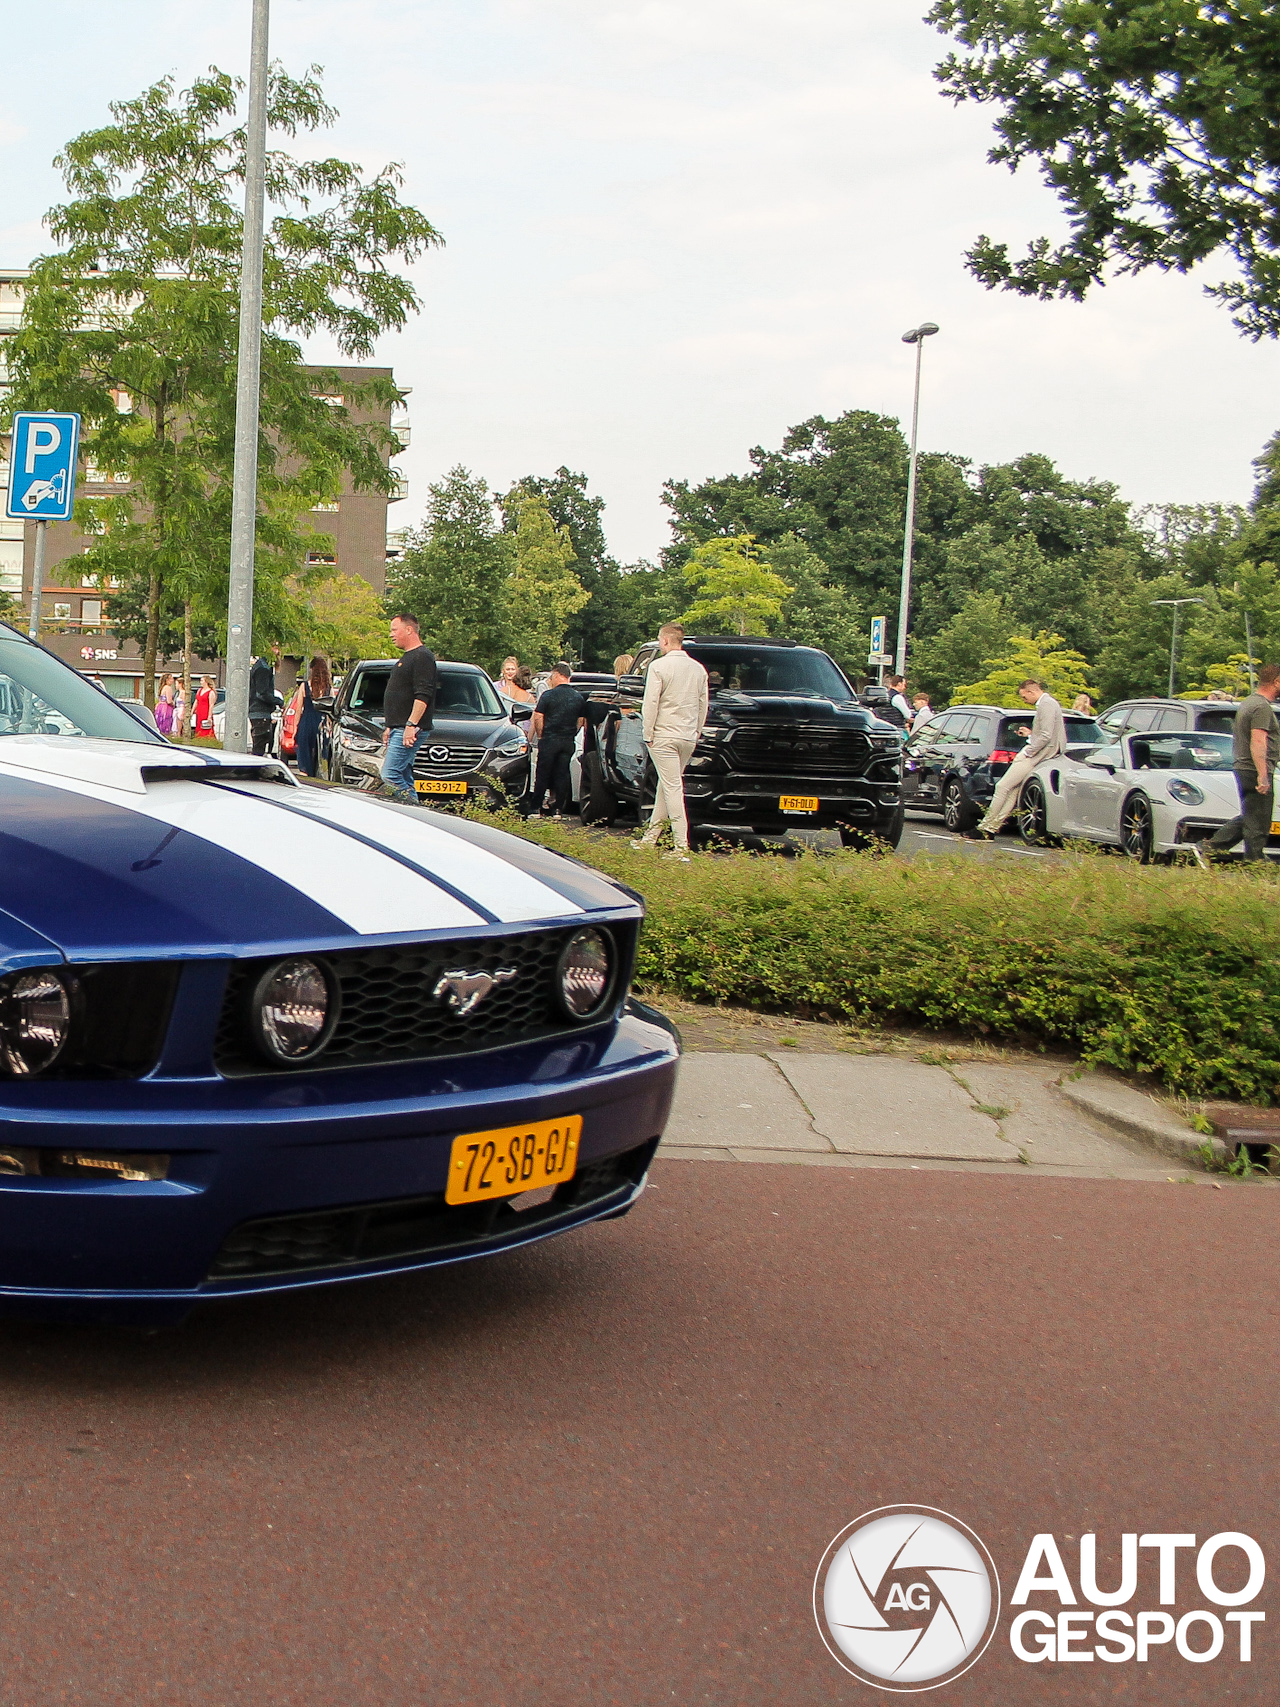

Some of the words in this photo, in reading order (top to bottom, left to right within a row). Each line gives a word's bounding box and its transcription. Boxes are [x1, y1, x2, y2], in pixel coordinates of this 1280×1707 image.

[25, 422, 61, 473] P
[95, 649, 117, 660] SNS
[419, 782, 461, 792] KS-391-Z
[463, 1127, 571, 1192] 72-SB-GJ
